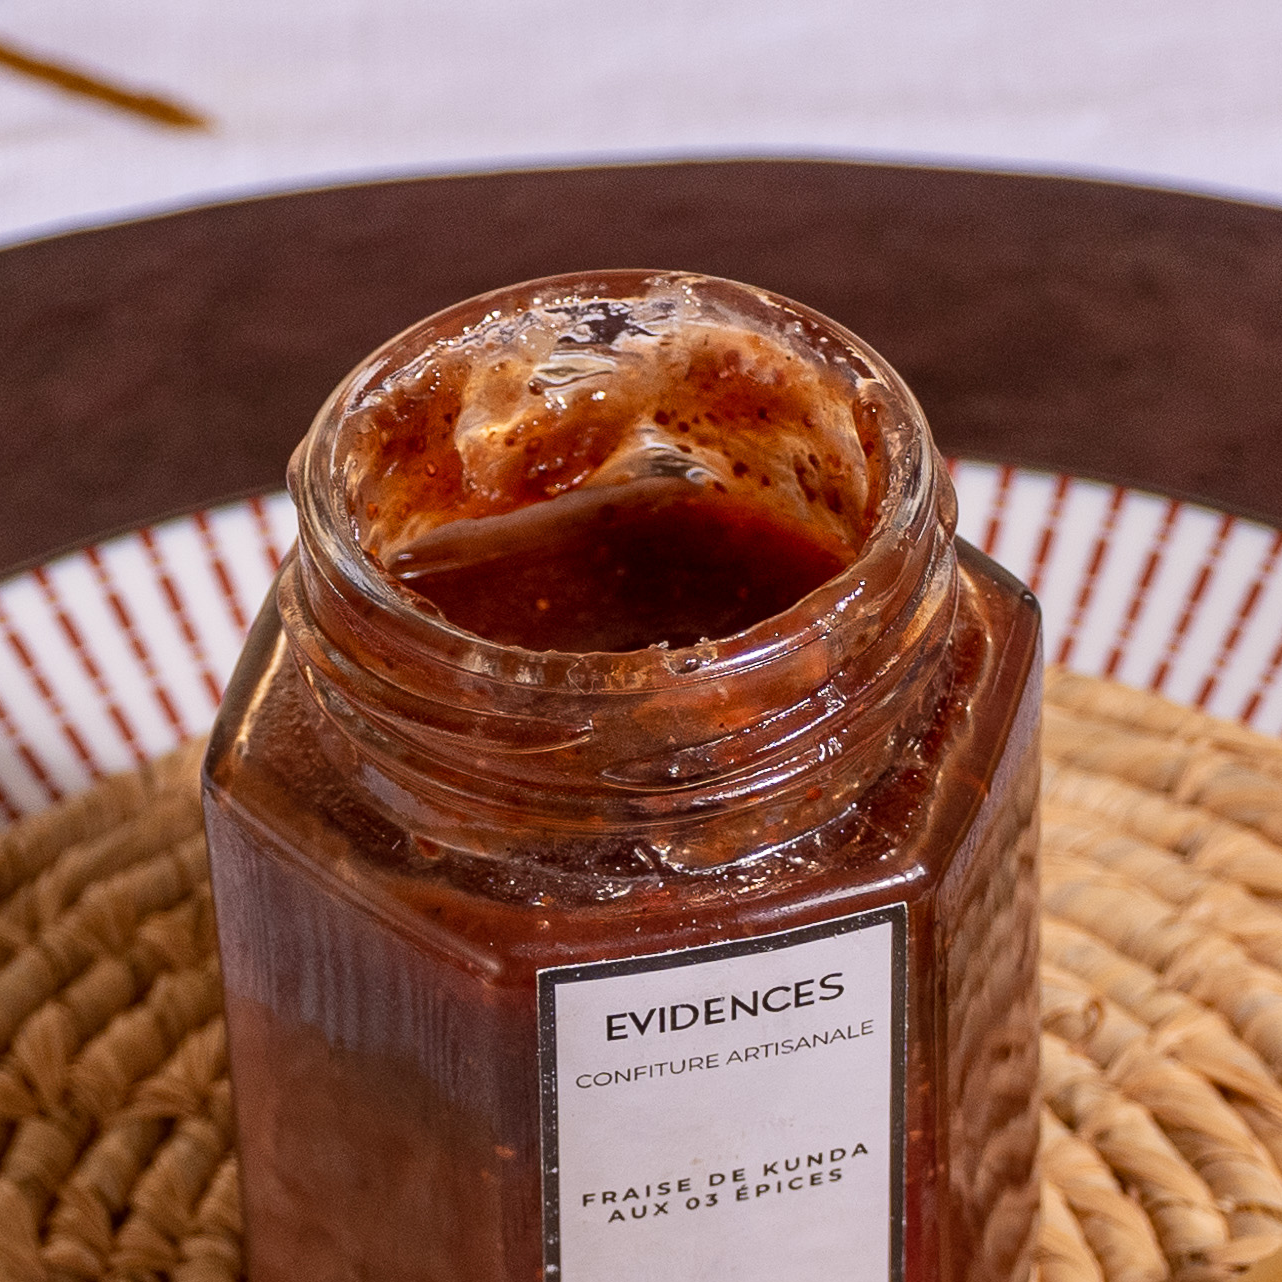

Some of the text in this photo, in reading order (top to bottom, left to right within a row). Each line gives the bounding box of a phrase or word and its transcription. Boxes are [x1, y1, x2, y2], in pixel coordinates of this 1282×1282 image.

[606, 972, 845, 1041] EVIDENCES
[575, 1019, 875, 1089] CONFITURE ARTISANALE
[582, 1143, 869, 1207] FRAISE DE KUNDA
[607, 1168, 844, 1223] AUX 03 ÉPICES
